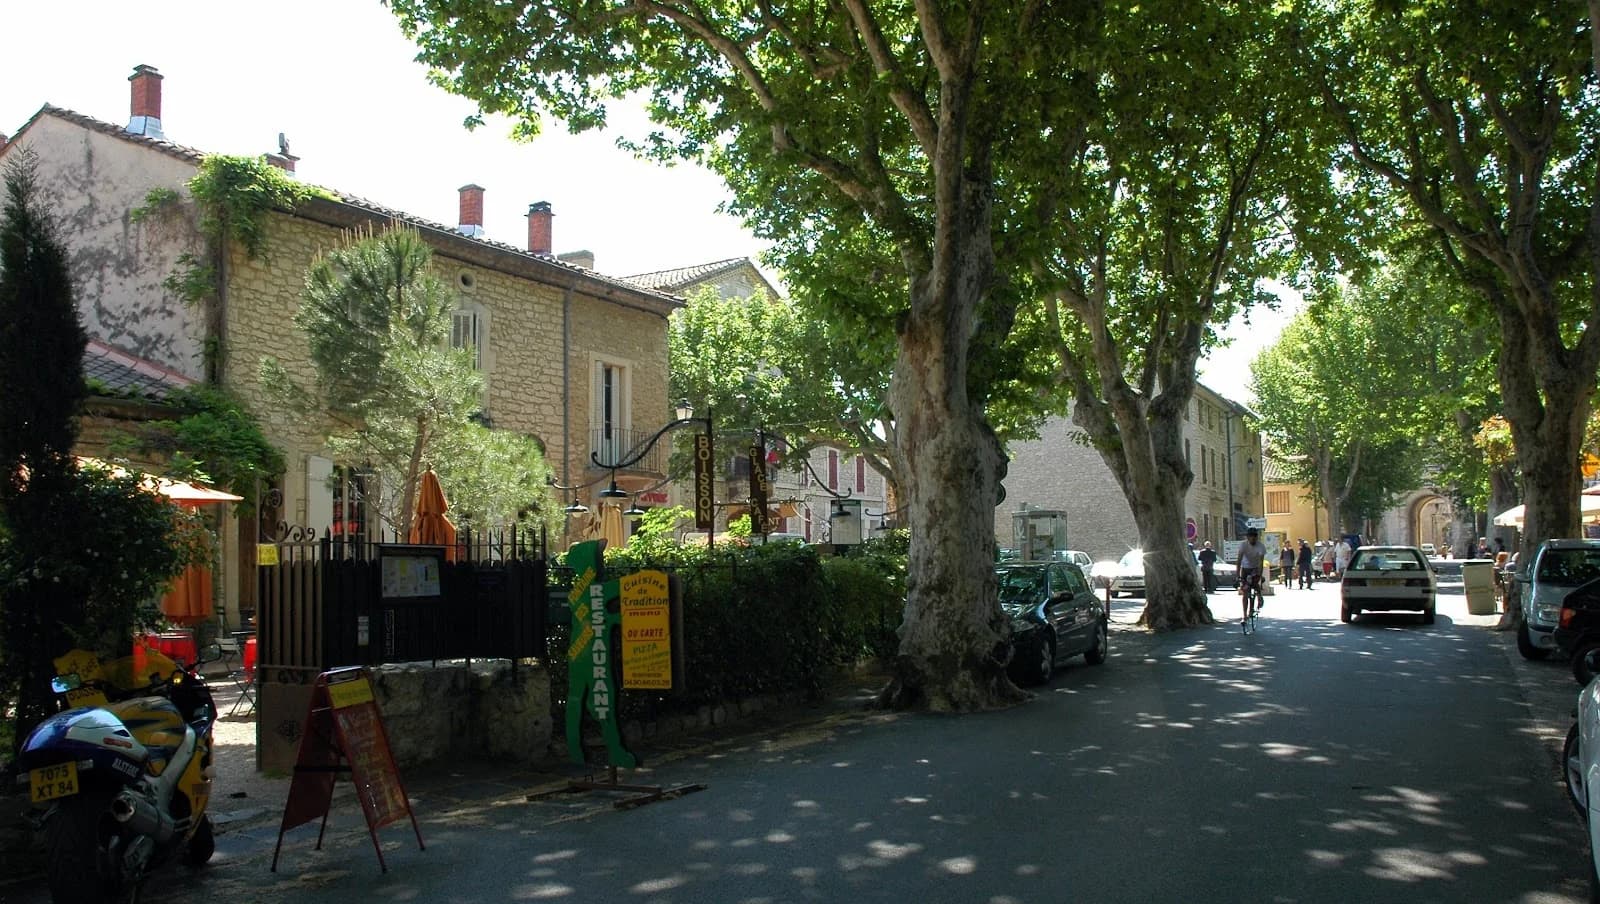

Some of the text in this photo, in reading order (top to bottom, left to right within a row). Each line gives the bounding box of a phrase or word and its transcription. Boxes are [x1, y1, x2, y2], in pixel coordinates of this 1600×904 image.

[698, 436, 711, 522] BOISSON
[749, 448, 767, 492] GLACE
[623, 575, 666, 592] Cuisine
[623, 597, 668, 607] Tradition
[590, 584, 610, 720] RESTAURANT
[38, 780, 73, 798] XT 84
